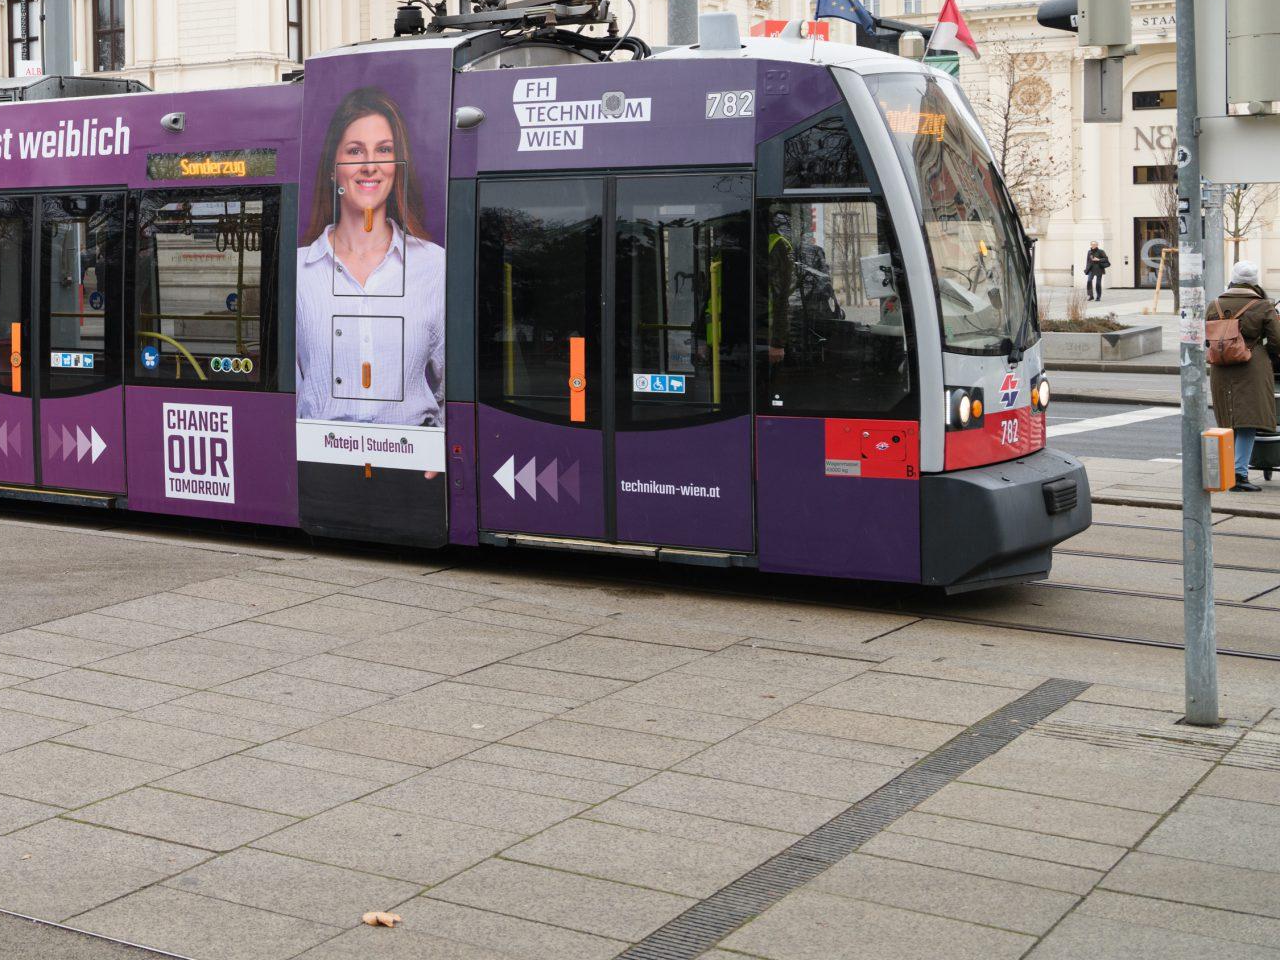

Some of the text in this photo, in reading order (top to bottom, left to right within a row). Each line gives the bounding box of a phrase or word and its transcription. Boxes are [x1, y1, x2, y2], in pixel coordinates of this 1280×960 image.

[526, 82, 550, 98] FH
[525, 102, 644, 123] TECHNIKM
[707, 91, 754, 119] 782
[19, 117, 131, 159] weiblich
[526, 130, 577, 147] WIEN
[180, 158, 246, 177] Sonderzug
[167, 409, 229, 433] CHANGE
[1001, 419, 1019, 445] 782
[324, 434, 359, 451] Mateja
[167, 435, 230, 478] OUR
[169, 477, 231, 497] TOMORROW
[621, 479, 721, 499] technikum-wien.at
